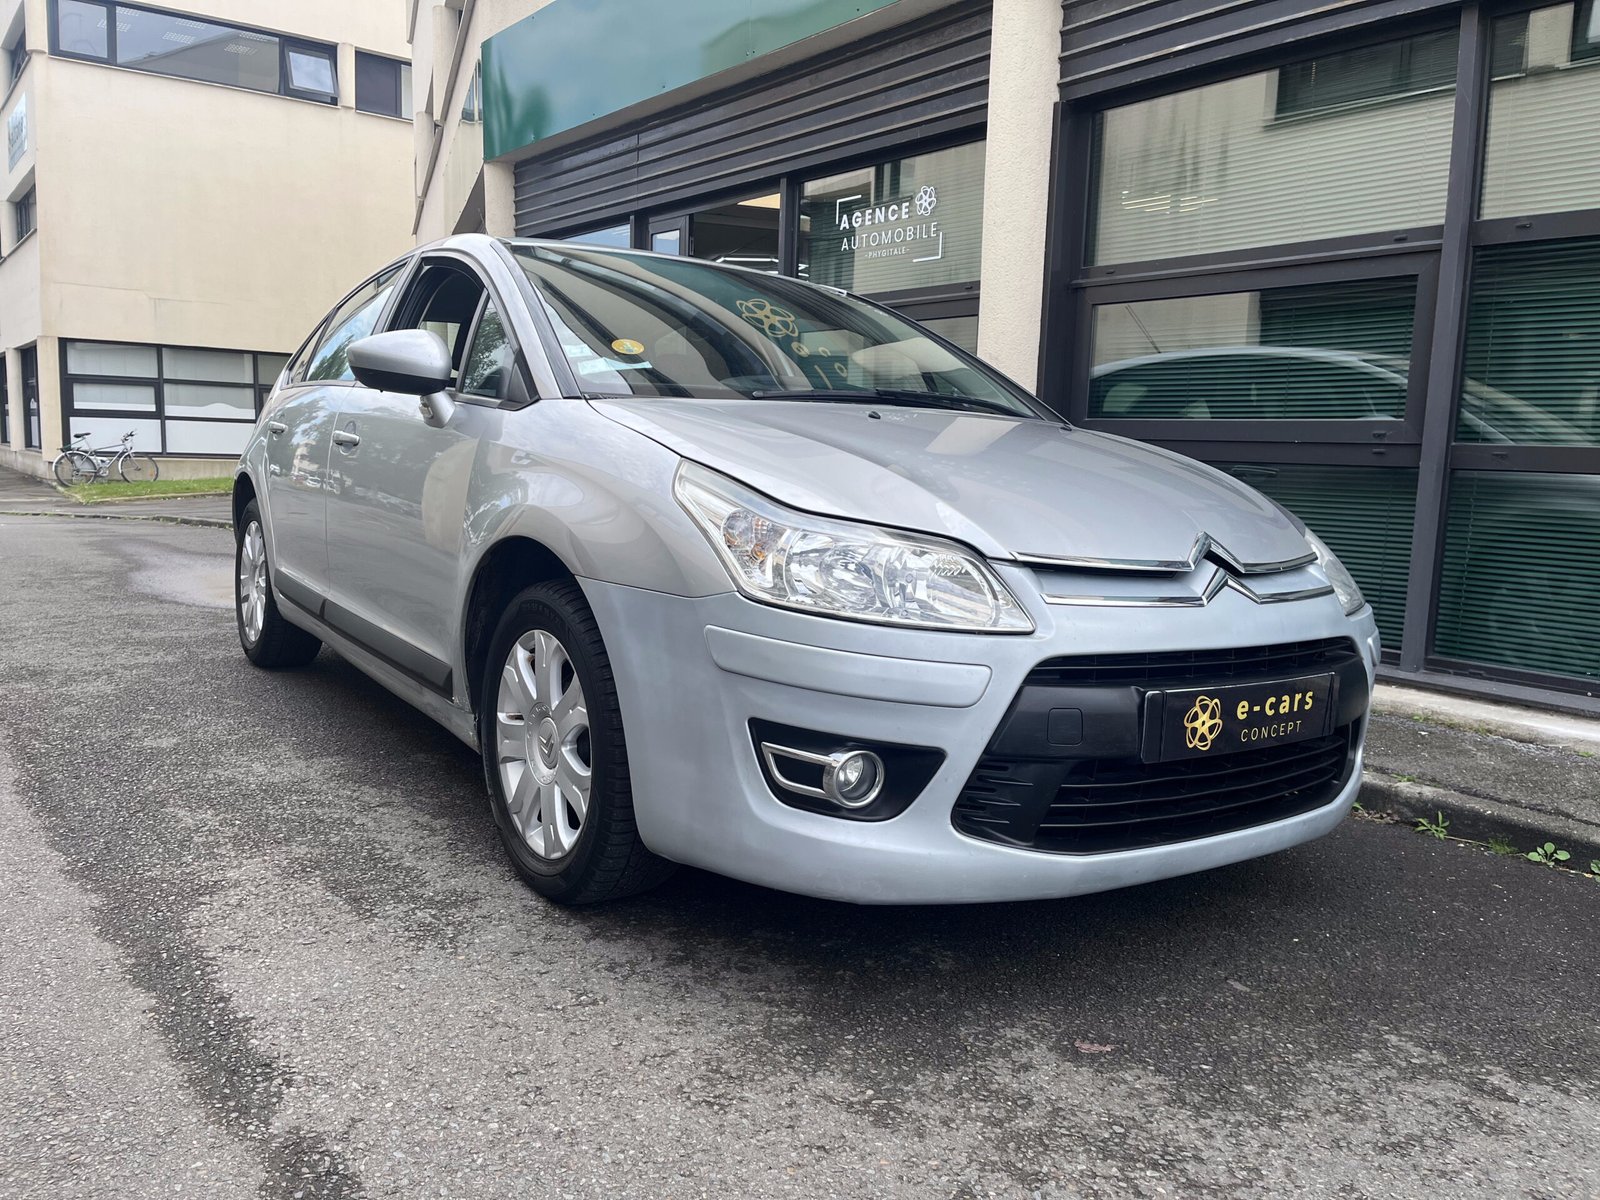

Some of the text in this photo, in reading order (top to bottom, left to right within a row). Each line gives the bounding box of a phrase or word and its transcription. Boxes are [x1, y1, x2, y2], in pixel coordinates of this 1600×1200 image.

[840, 202, 910, 231] AGENCE
[841, 221, 938, 252] AUTOMOBILE
[1236, 690, 1314, 720] e-cars
[1240, 720, 1302, 742] CONCEPT
